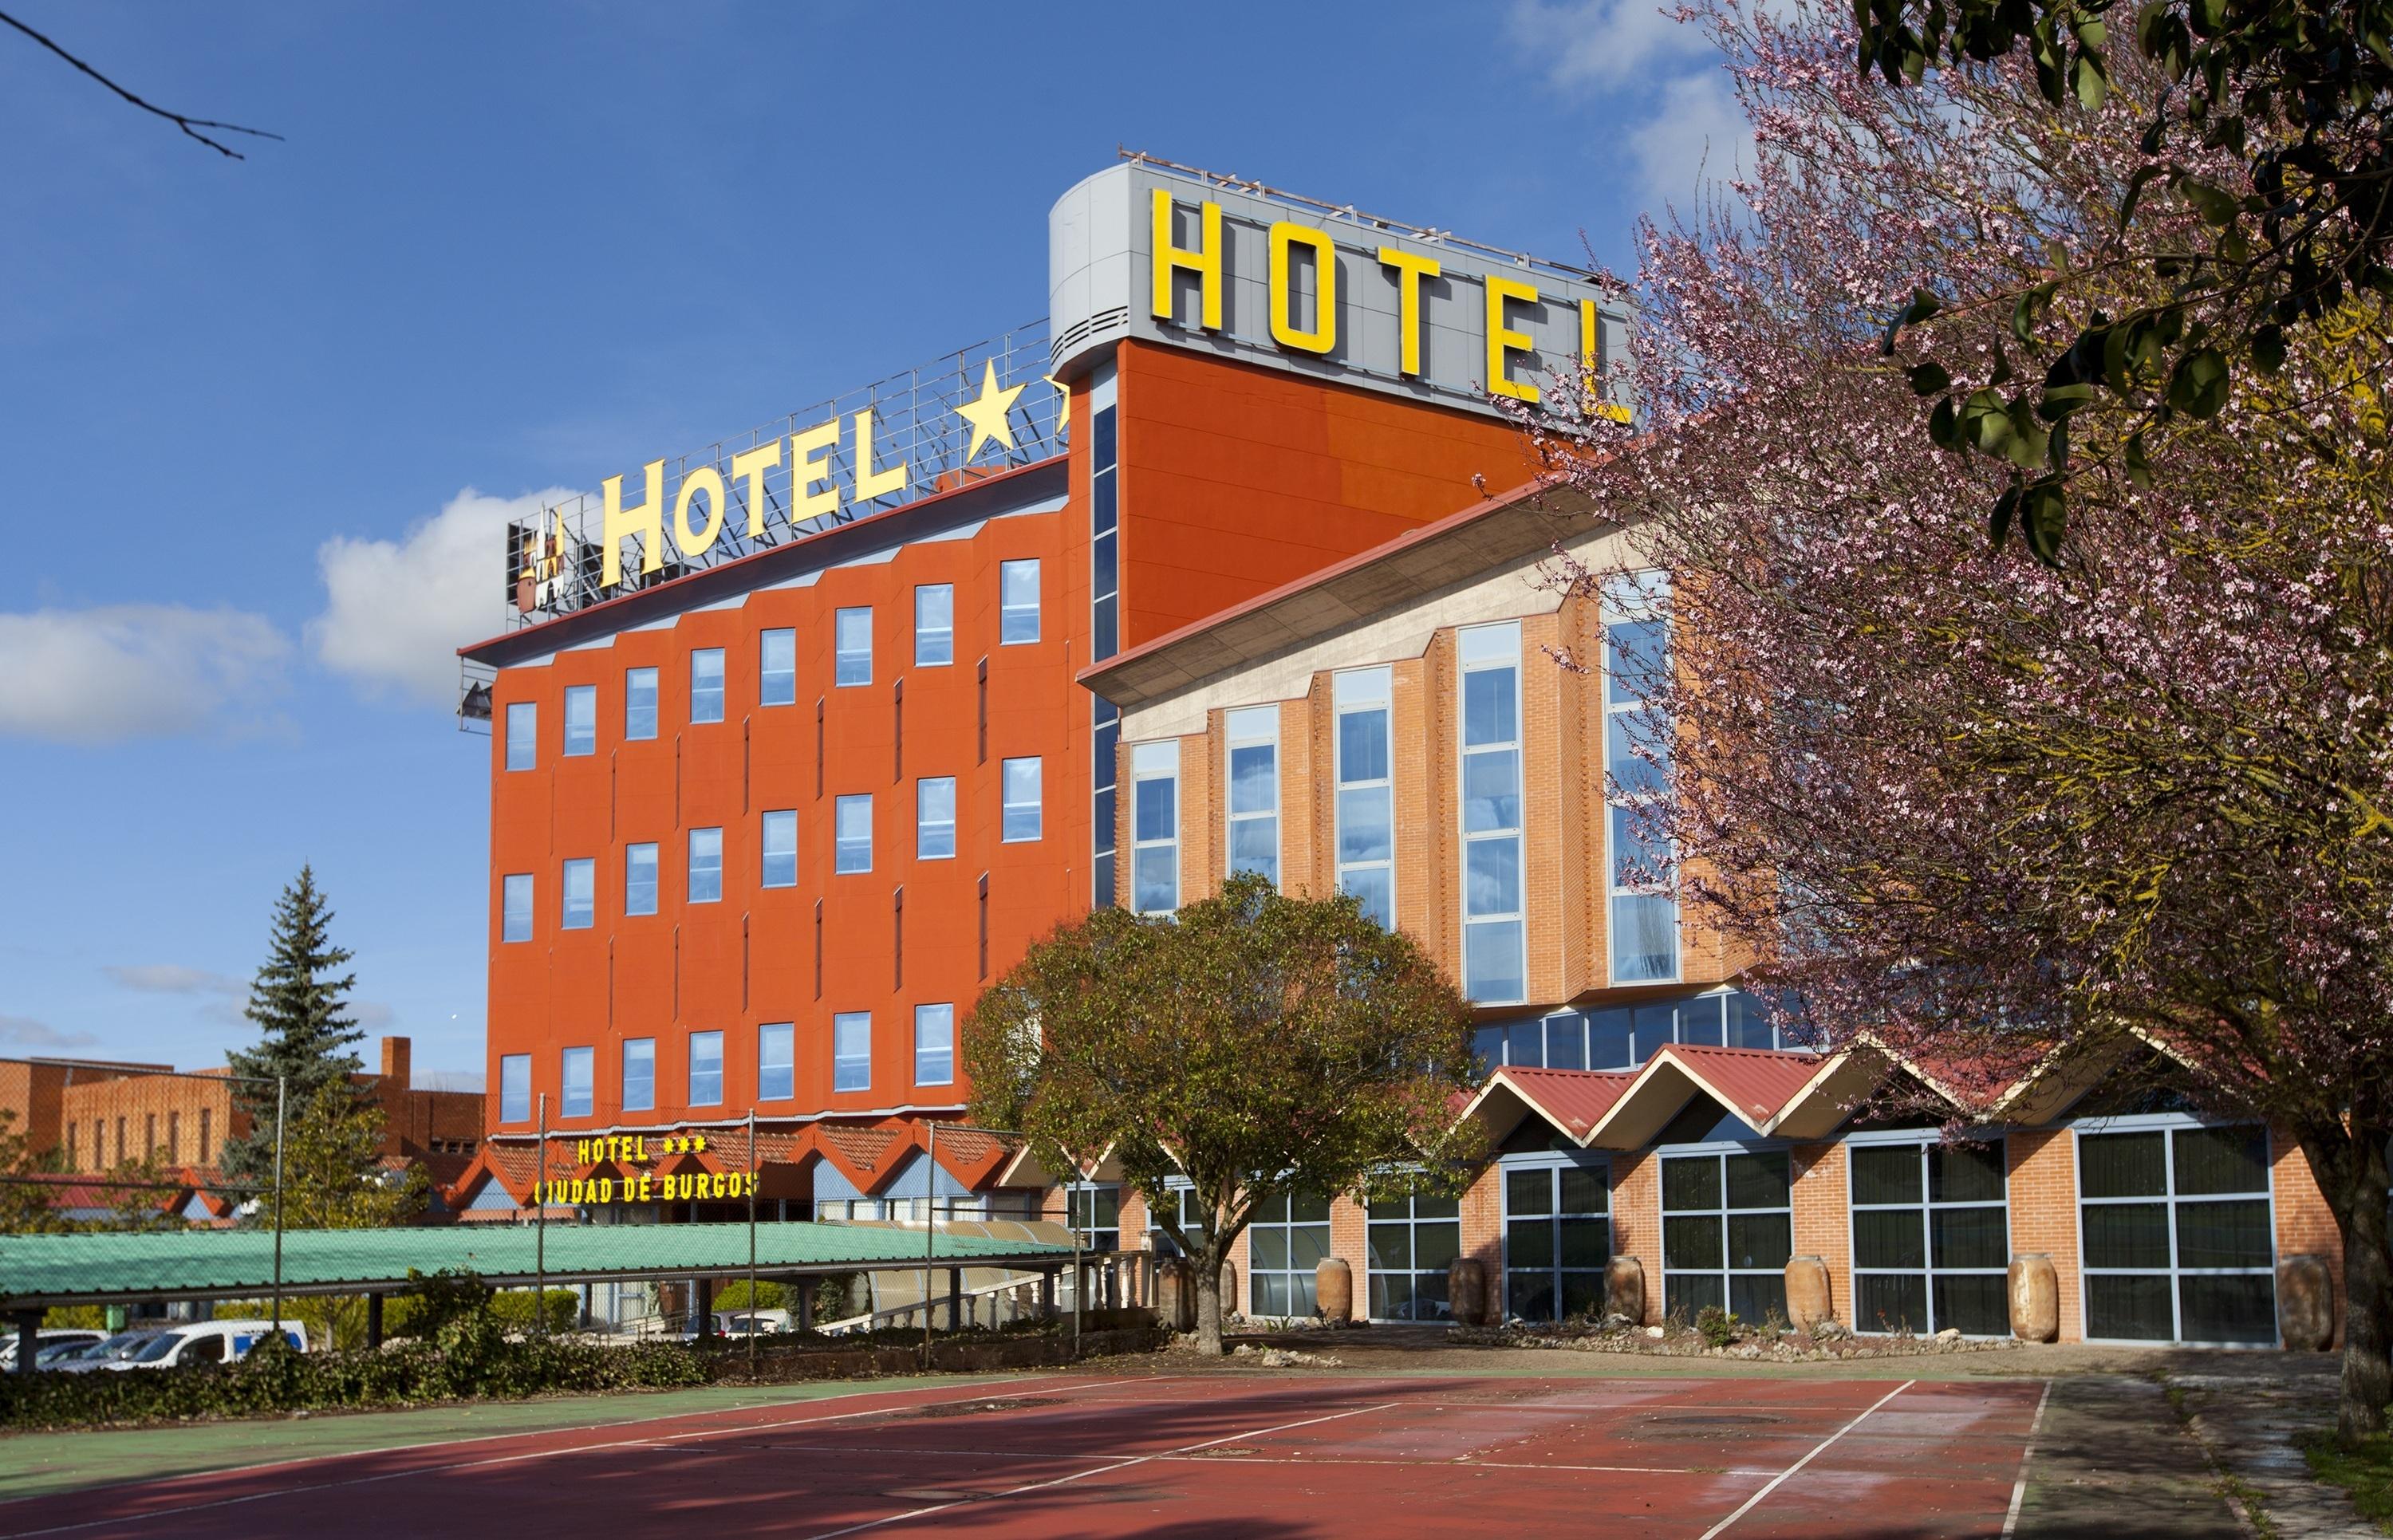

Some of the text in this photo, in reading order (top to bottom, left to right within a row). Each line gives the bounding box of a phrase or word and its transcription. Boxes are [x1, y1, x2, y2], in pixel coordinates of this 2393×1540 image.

[1149, 187, 1630, 424] HOTEL
[600, 408, 907, 589] HOTEL
[578, 1136, 649, 1164] HOTEL
[624, 1176, 651, 1202] DE
[664, 1172, 760, 1200] BURGOS
